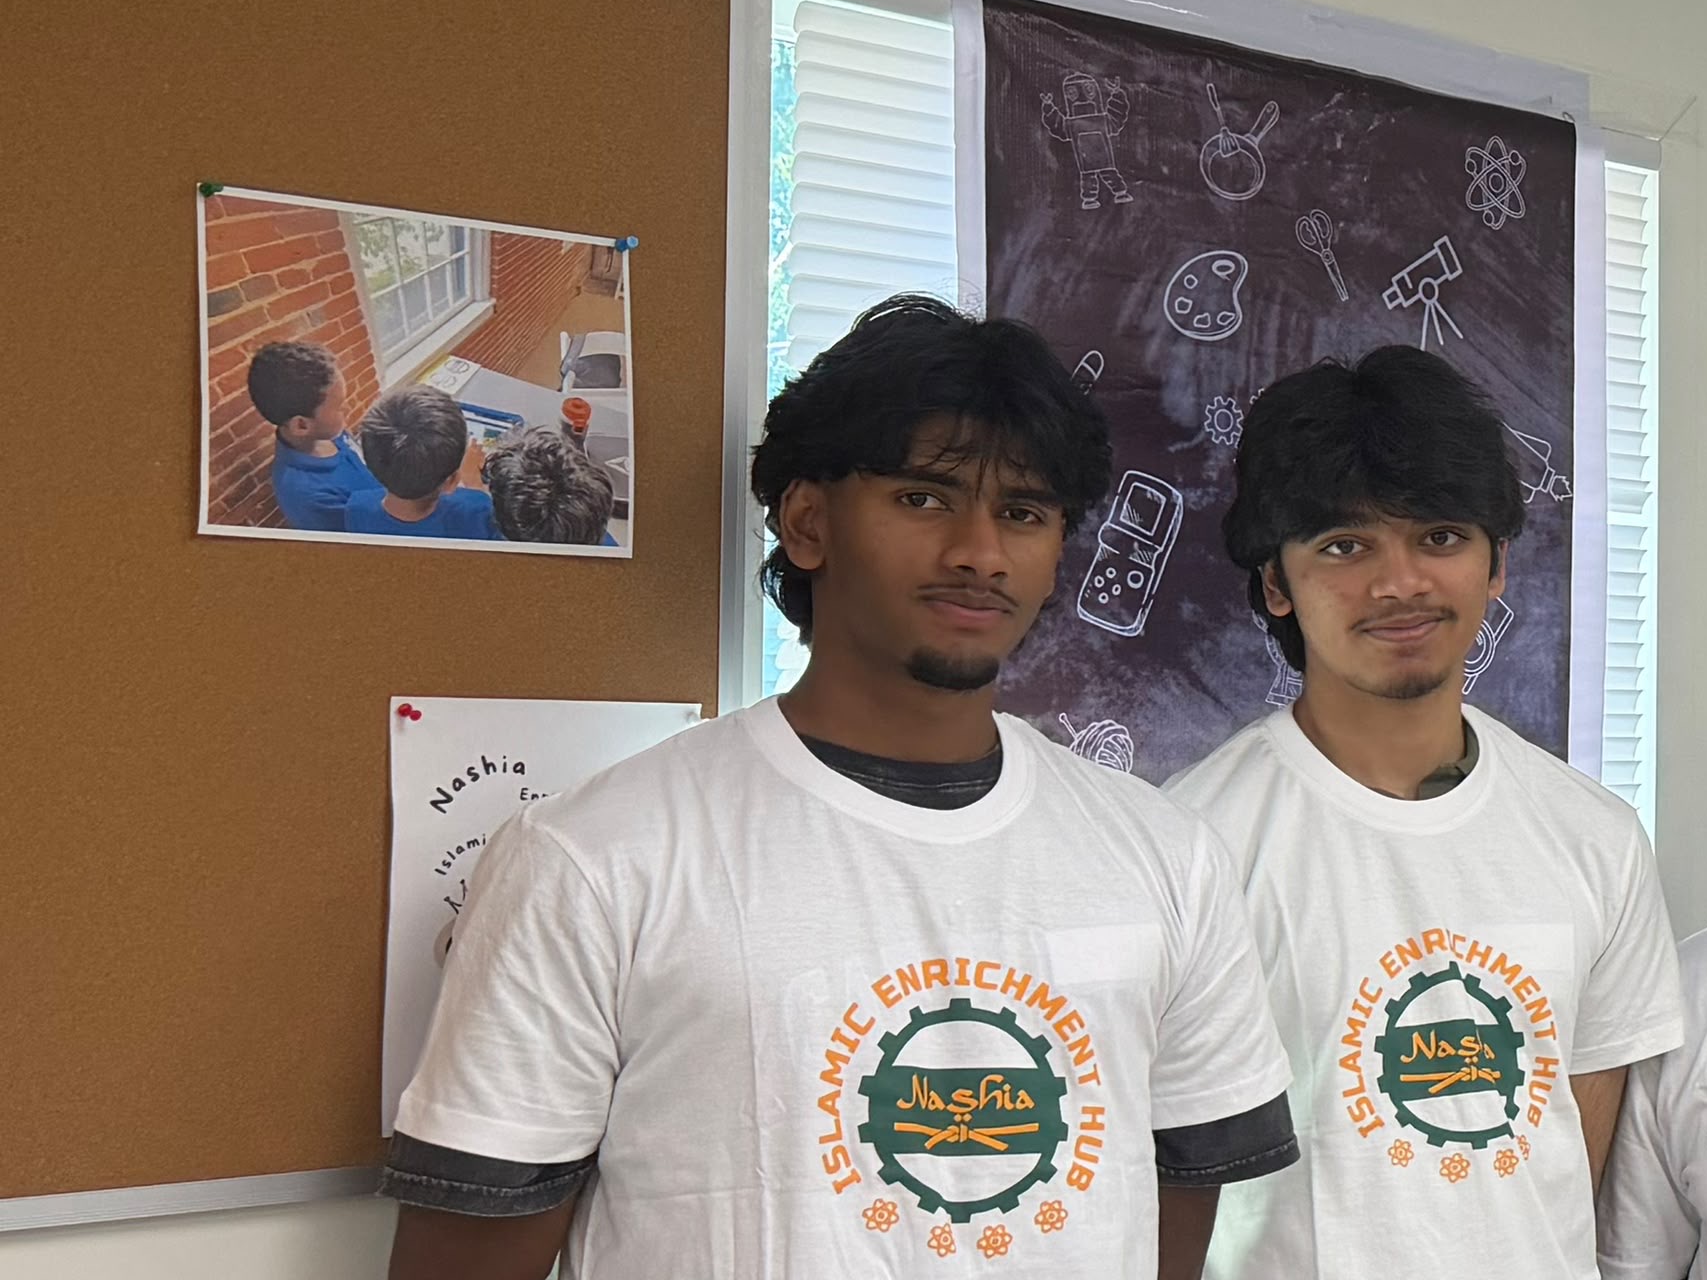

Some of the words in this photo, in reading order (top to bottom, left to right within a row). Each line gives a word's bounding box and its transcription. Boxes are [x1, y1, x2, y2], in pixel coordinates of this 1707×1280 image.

[429, 755, 526, 814] Nashia
[434, 833, 487, 876] Islami
[817, 1002, 876, 1195] ISLAMIC
[871, 957, 1102, 1087] ENRICHMENT
[1066, 1106, 1106, 1192] HUB
[1339, 976, 1385, 1138] ISLAMIC
[1527, 1056, 1560, 1128] HUB
[896, 1073, 1035, 1113] Nashia
